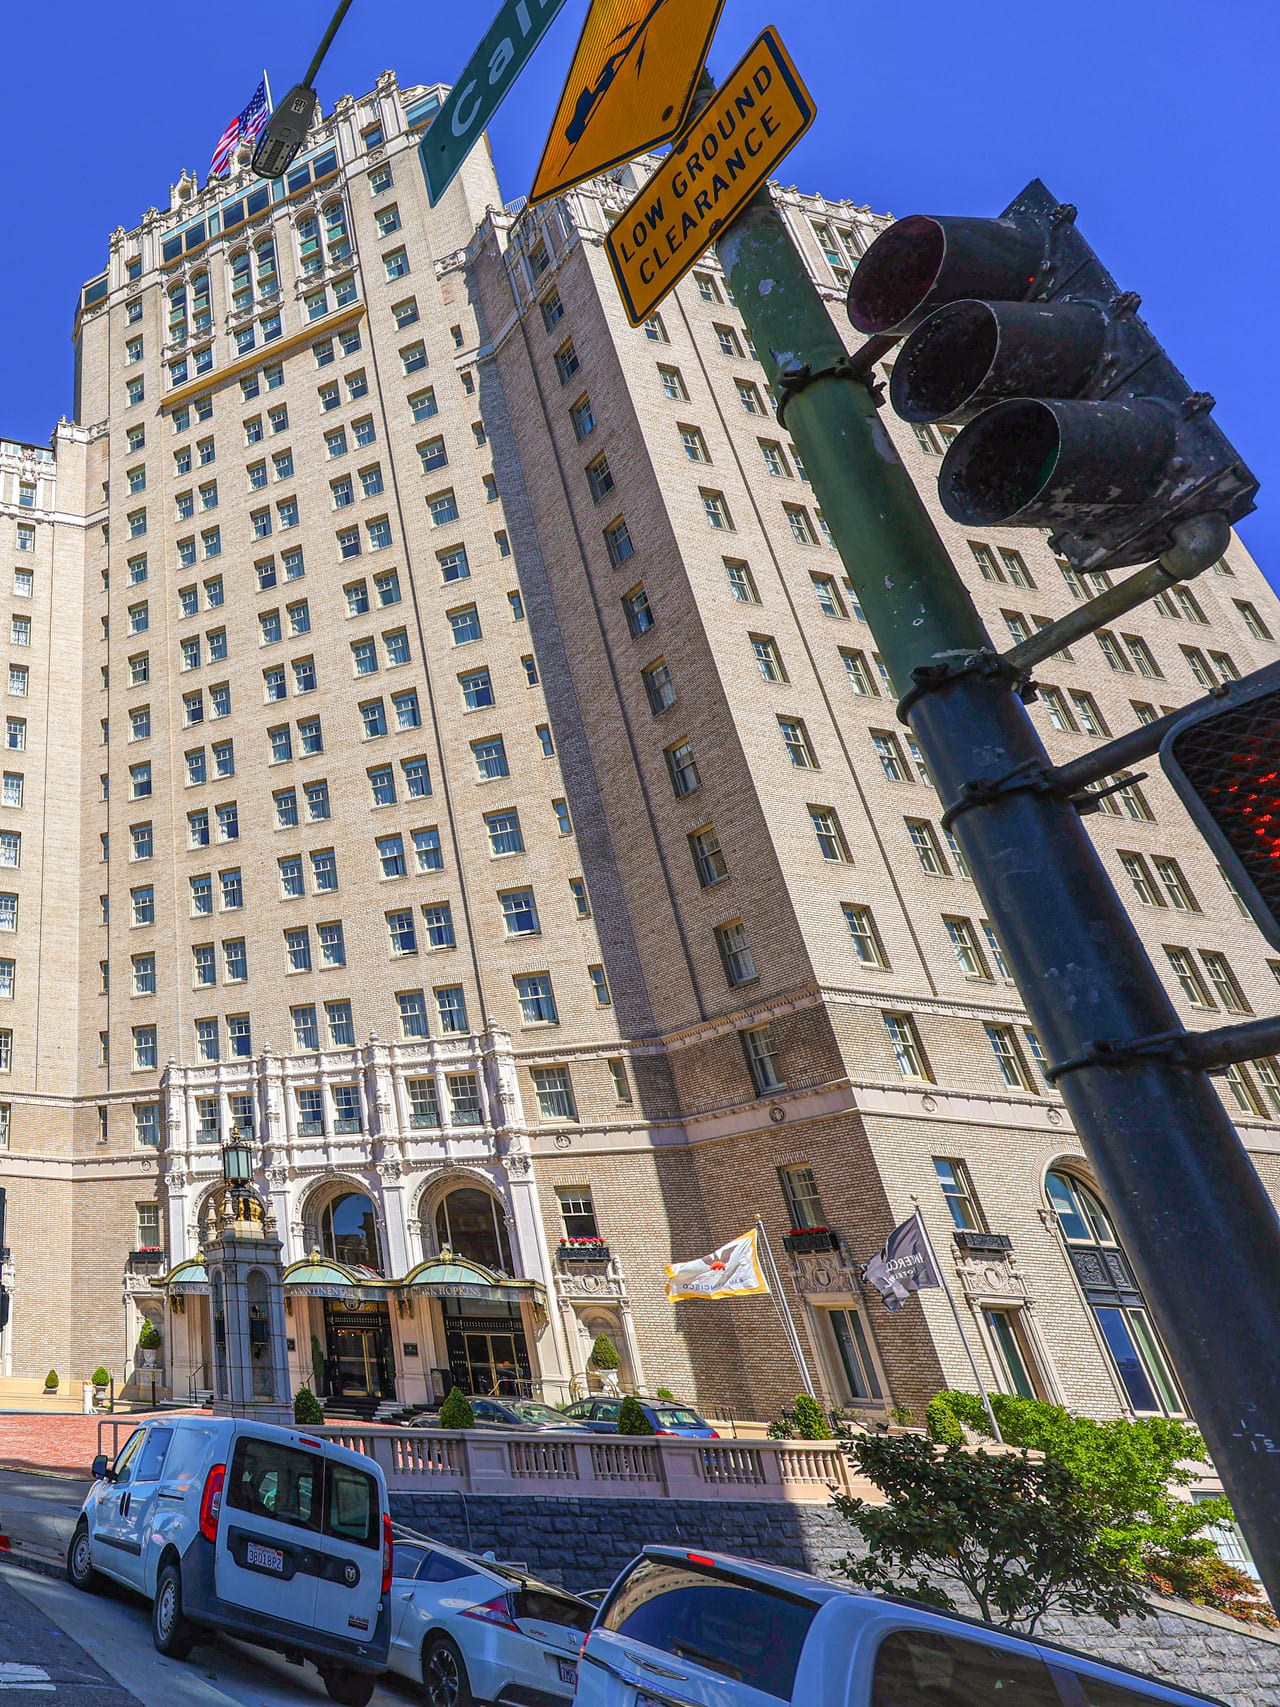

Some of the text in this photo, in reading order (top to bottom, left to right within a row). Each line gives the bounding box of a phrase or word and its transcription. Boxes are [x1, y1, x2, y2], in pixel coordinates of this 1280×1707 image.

[451, 0, 547, 136] Cal
[620, 64, 773, 263] LOW GROUND
[639, 107, 781, 284] CLEARANCE
[439, 1286, 481, 1297] HOPKINS
